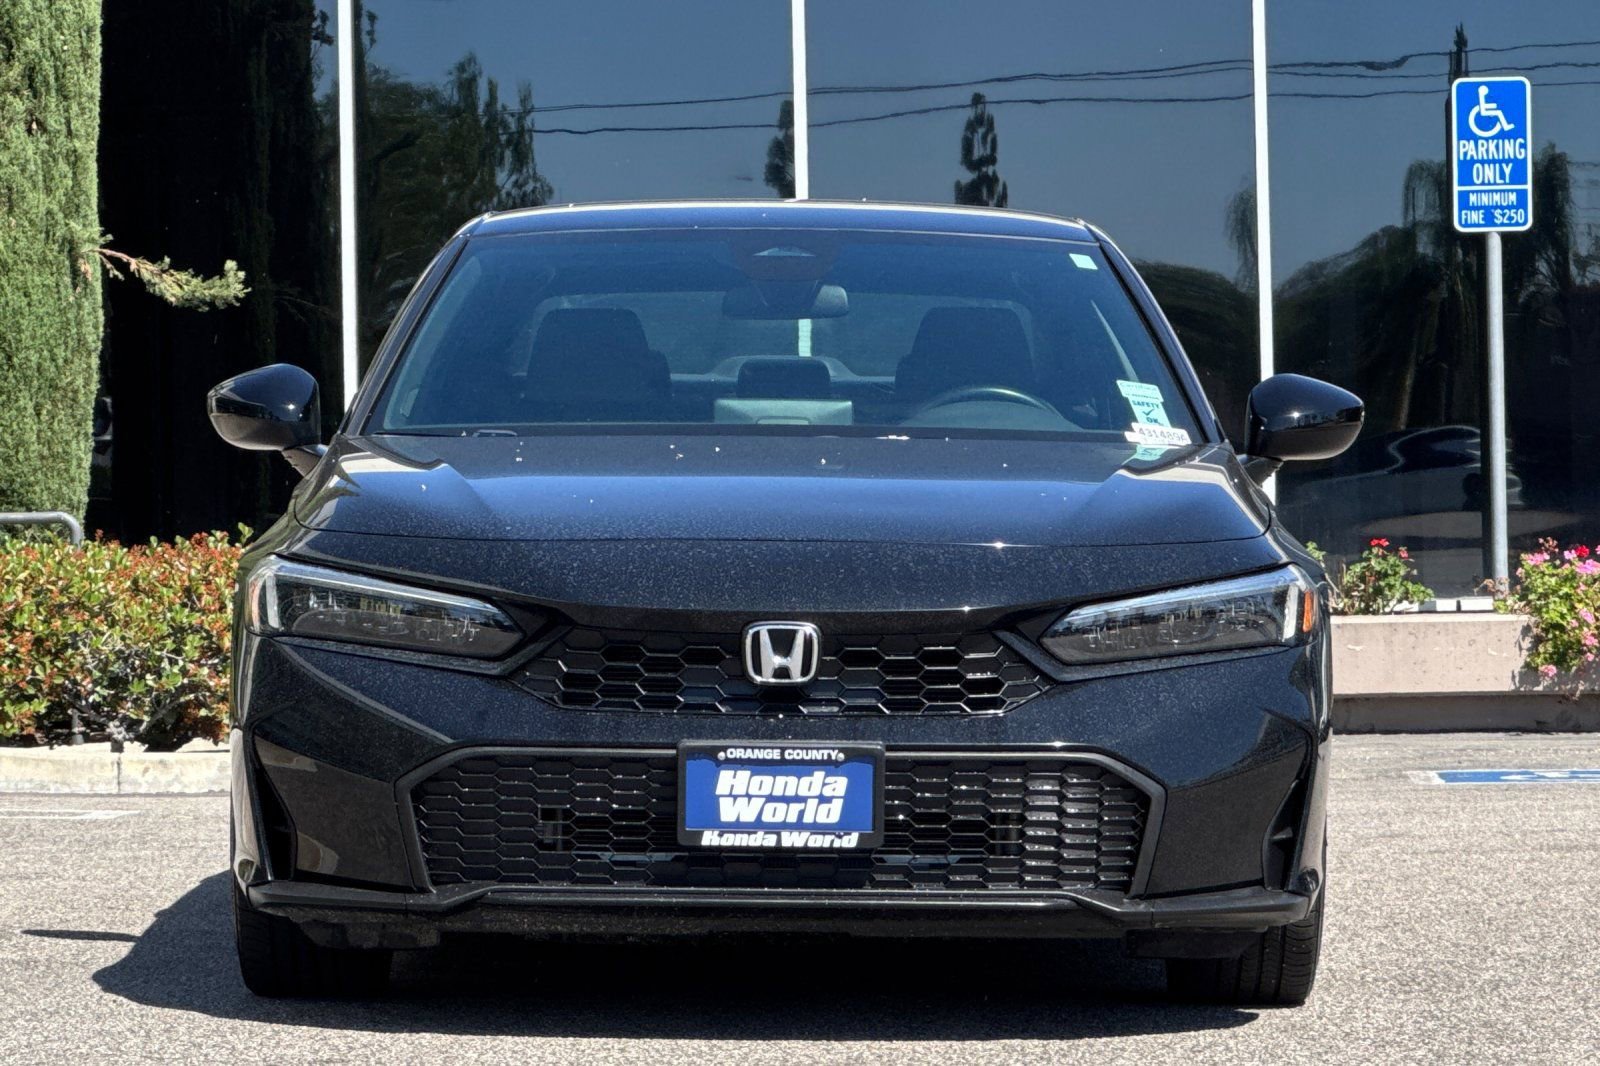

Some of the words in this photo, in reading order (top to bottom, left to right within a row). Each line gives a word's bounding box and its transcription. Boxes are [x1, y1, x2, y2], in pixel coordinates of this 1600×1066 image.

[1459, 138, 1525, 160] PARKING
[1472, 163, 1513, 185] ONLY
[1469, 191, 1517, 207] MINIMUM
[1461, 210, 1486, 224] FINE
[1494, 208, 1525, 224] $250
[1131, 400, 1160, 409] SAFETY
[726, 748, 781, 760] ORANGE
[784, 749, 838, 760] COUNTY
[715, 770, 848, 797] Honda
[719, 797, 844, 823] World
[701, 830, 777, 846] Honda
[780, 831, 860, 848] World
